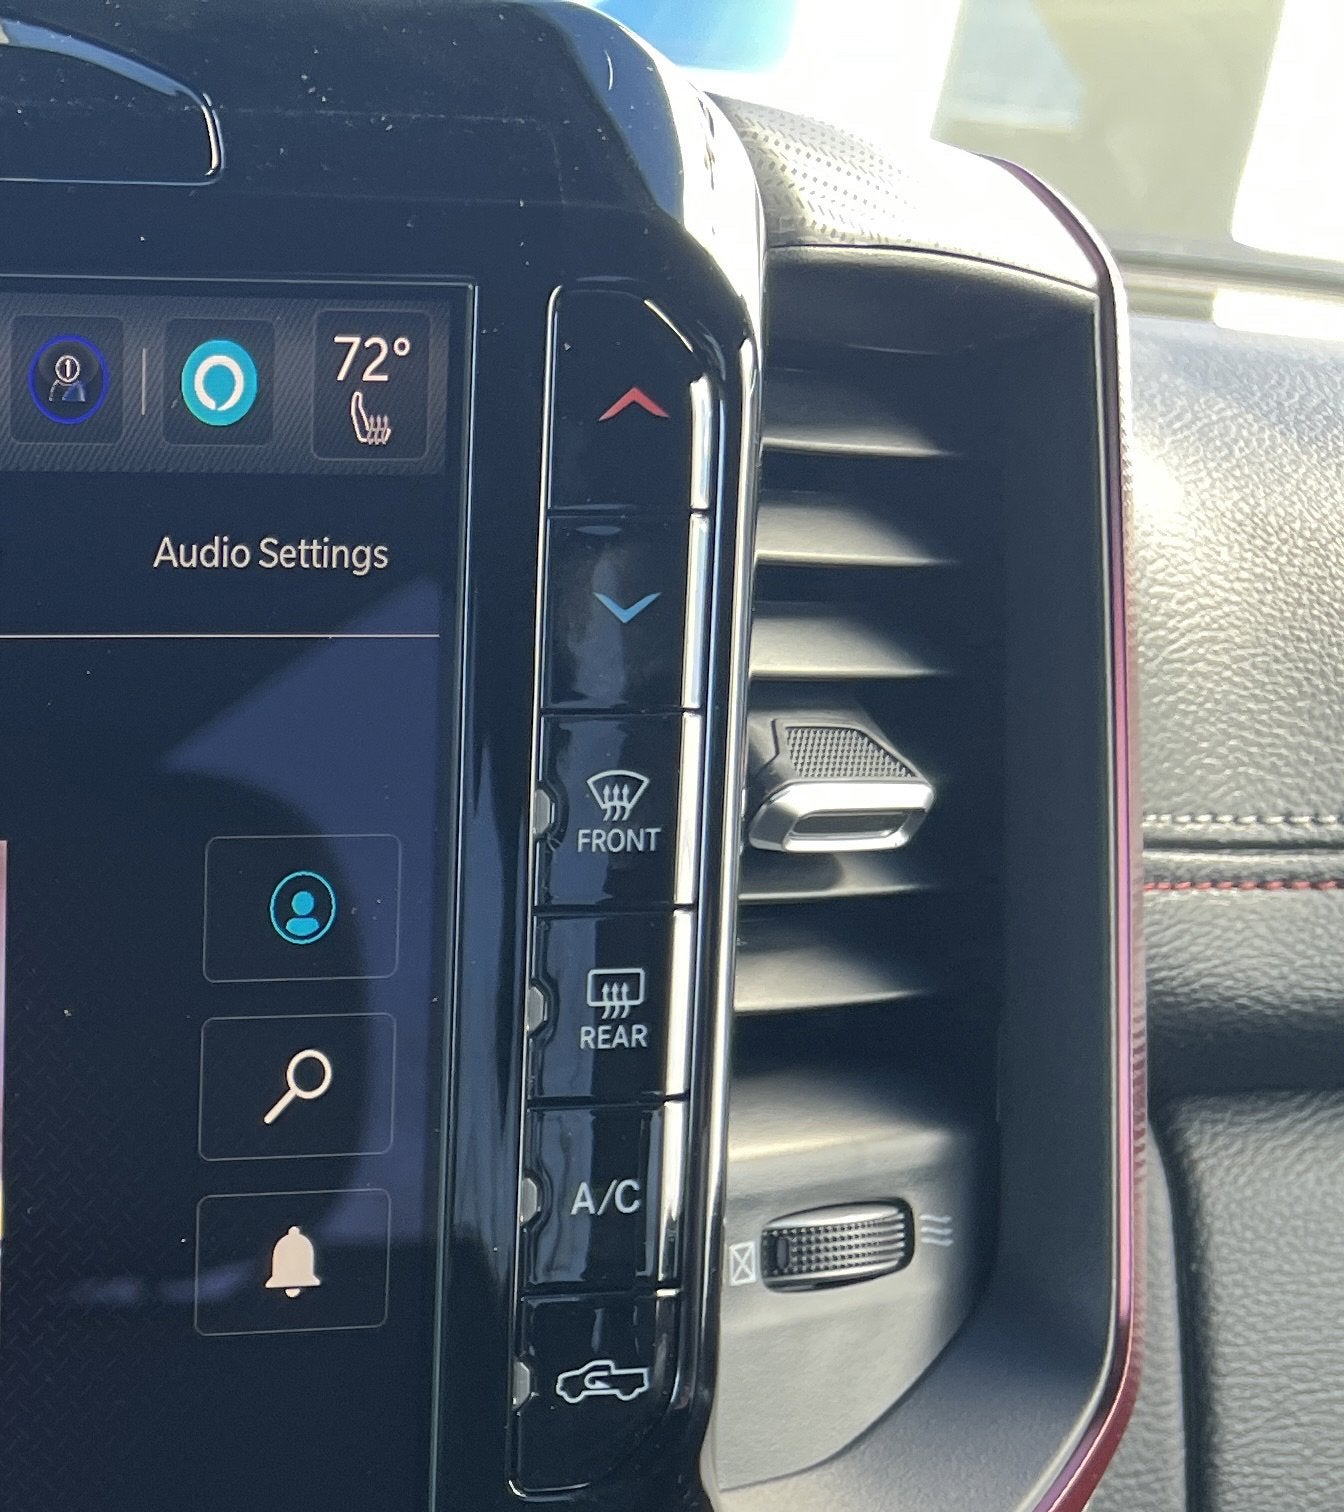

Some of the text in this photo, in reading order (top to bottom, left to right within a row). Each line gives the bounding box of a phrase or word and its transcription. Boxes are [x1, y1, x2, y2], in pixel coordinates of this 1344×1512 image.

[333, 335, 411, 382] 72°
[153, 536, 390, 576] Audio Settings
[576, 828, 662, 854] FRONT
[579, 1025, 649, 1051] REAR
[570, 1180, 641, 1215] A/C
